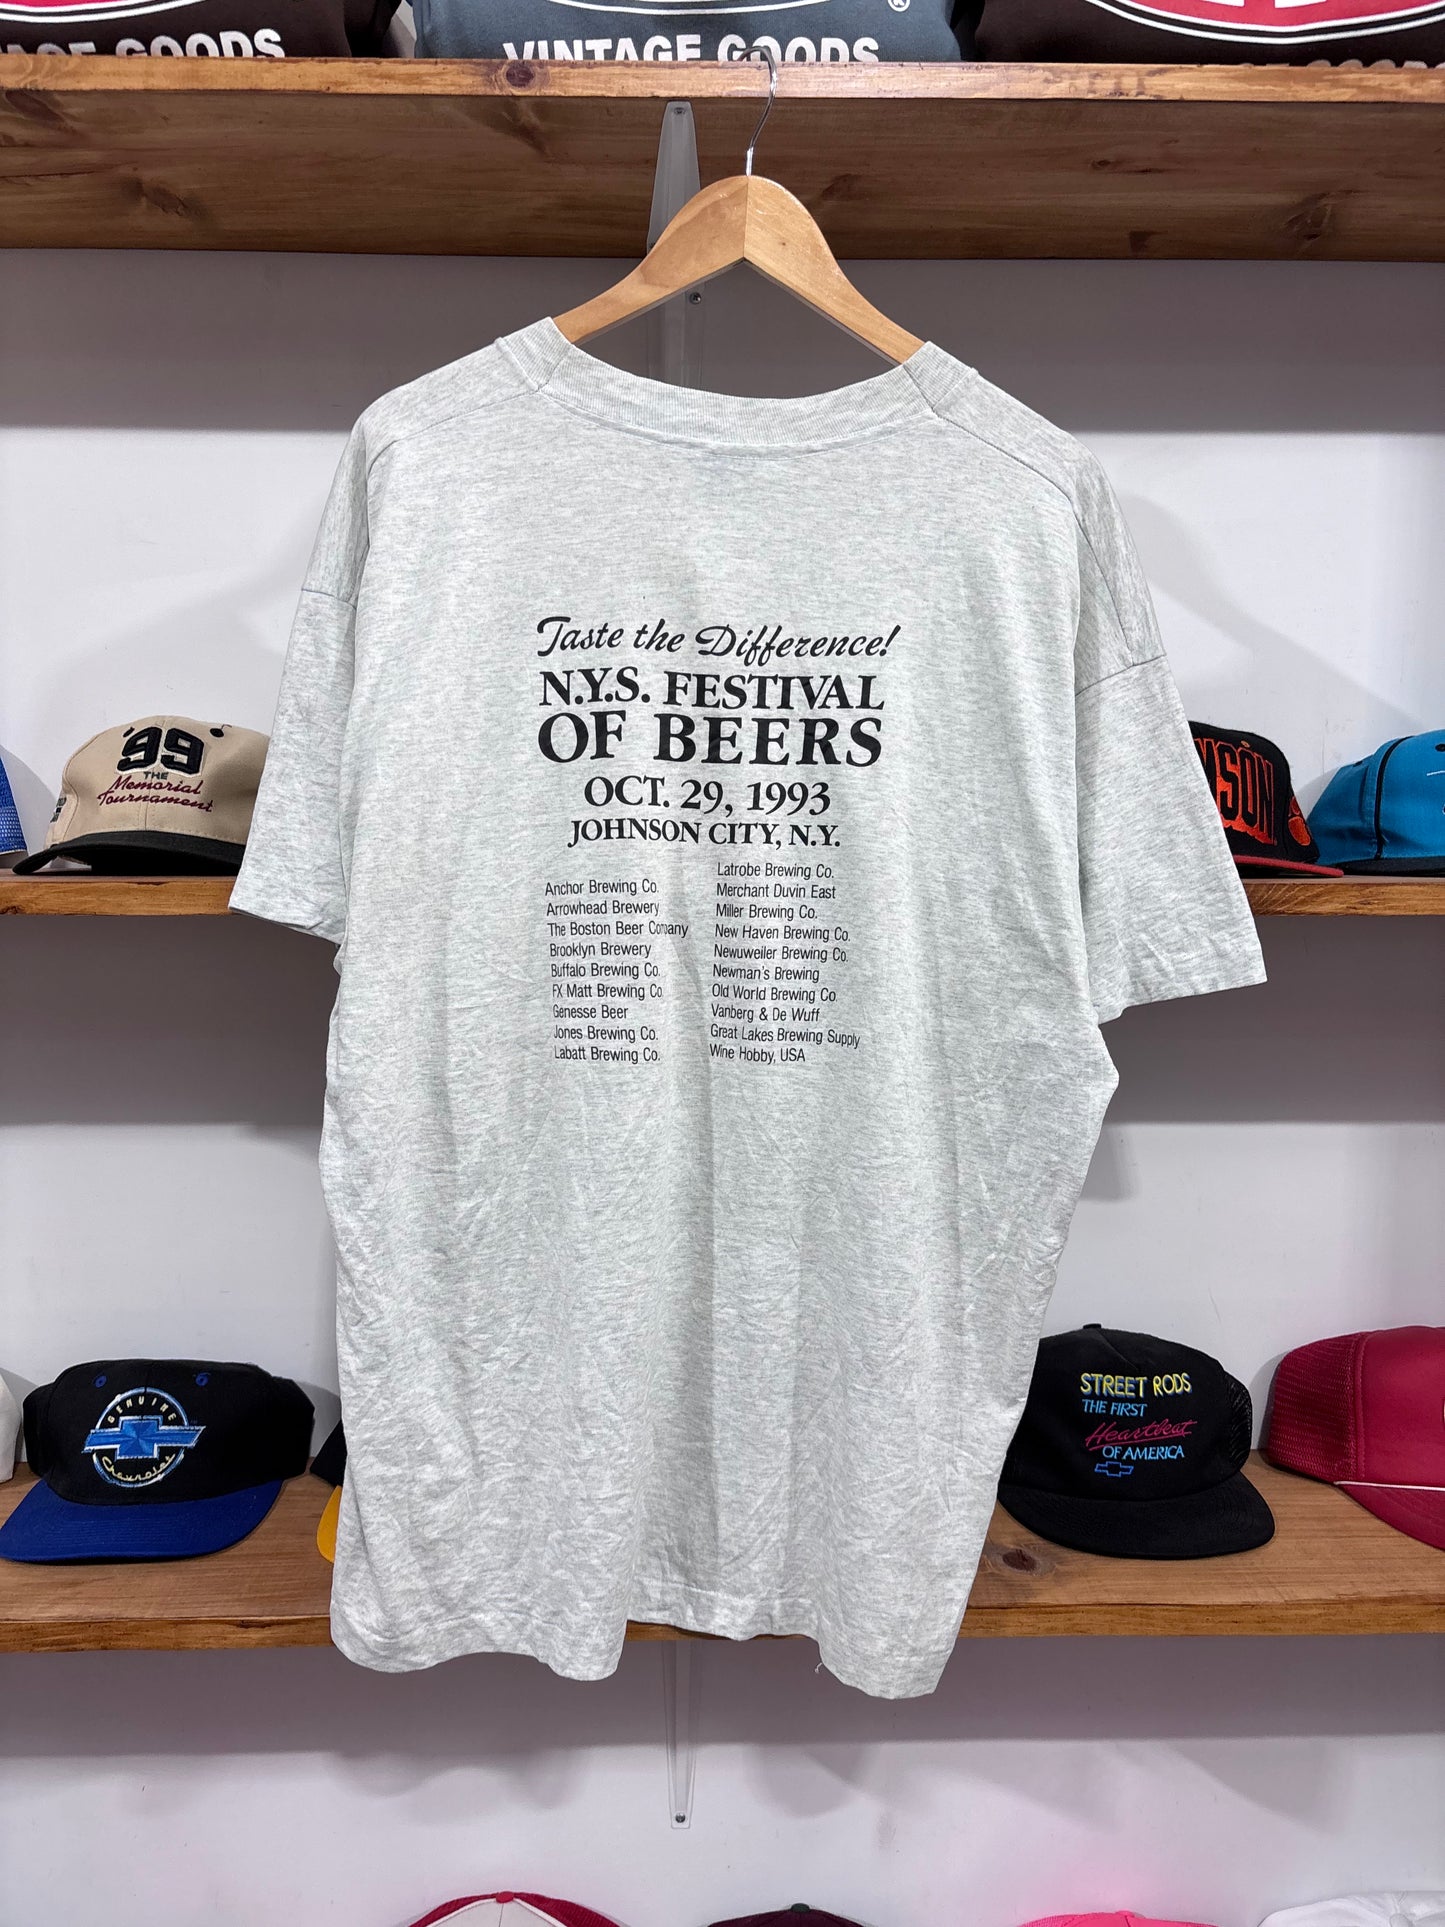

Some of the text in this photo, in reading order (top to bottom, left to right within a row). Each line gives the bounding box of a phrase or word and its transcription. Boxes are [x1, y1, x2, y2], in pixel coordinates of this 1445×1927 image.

[503, 34, 880, 62] VINTAGE GOODS
[537, 616, 901, 667] Taste the Difference!
[539, 666, 885, 710] N.Y.S. FESTIVAL
[538, 710, 882, 767] OF BEERS
[107, 775, 204, 795] Memorial
[143, 771, 169, 780] THE
[97, 790, 213, 813] Tournament
[584, 775, 831, 818] OCT. 29, 1993
[567, 818, 841, 850] JOHNSON CITY, N.Y.
[717, 862, 834, 880] Latrobe Brewing Co.
[545, 878, 660, 896] Anchor Brewing Co.
[716, 882, 836, 899] Merchant Duvin East
[546, 900, 660, 916] Arrowhead Brewery
[716, 903, 818, 921] Miller Brewing Co.
[547, 922, 566, 937] The
[570, 921, 611, 936] Boston
[615, 920, 644, 935] Beer
[715, 923, 850, 943] New Haven Brewing Co.
[549, 941, 652, 959] Brooklyn Brewery
[782, 946, 827, 963] Brewing
[833, 947, 848, 962] Co.
[551, 962, 661, 980] Buffalo Brewing Co.
[713, 963, 820, 984] Newman's Brewing
[552, 983, 563, 998] FX
[566, 983, 592, 998] Matt
[597, 983, 645, 1001] Brewing
[712, 983, 837, 1004] Old World Brewing Co.
[552, 1004, 629, 1019] Genesse Beer
[711, 1003, 820, 1023] Vanberg & De Wuff
[553, 1025, 658, 1043] Jones Brewing Co.
[710, 1023, 861, 1049] Great Lakes Brewing Supply
[554, 1045, 660, 1064] Labatt Brewing Co.
[709, 1043, 806, 1065] Wine Hobby, USA
[1080, 1372, 1192, 1398] STREET RODS
[107, 1396, 177, 1424] GENUINE
[1081, 1399, 1148, 1417] THE FIRST
[1085, 1418, 1198, 1448] Heartbeat
[1102, 1445, 1185, 1460] OF AMERICA
[102, 1453, 176, 1482] Chevrolet
